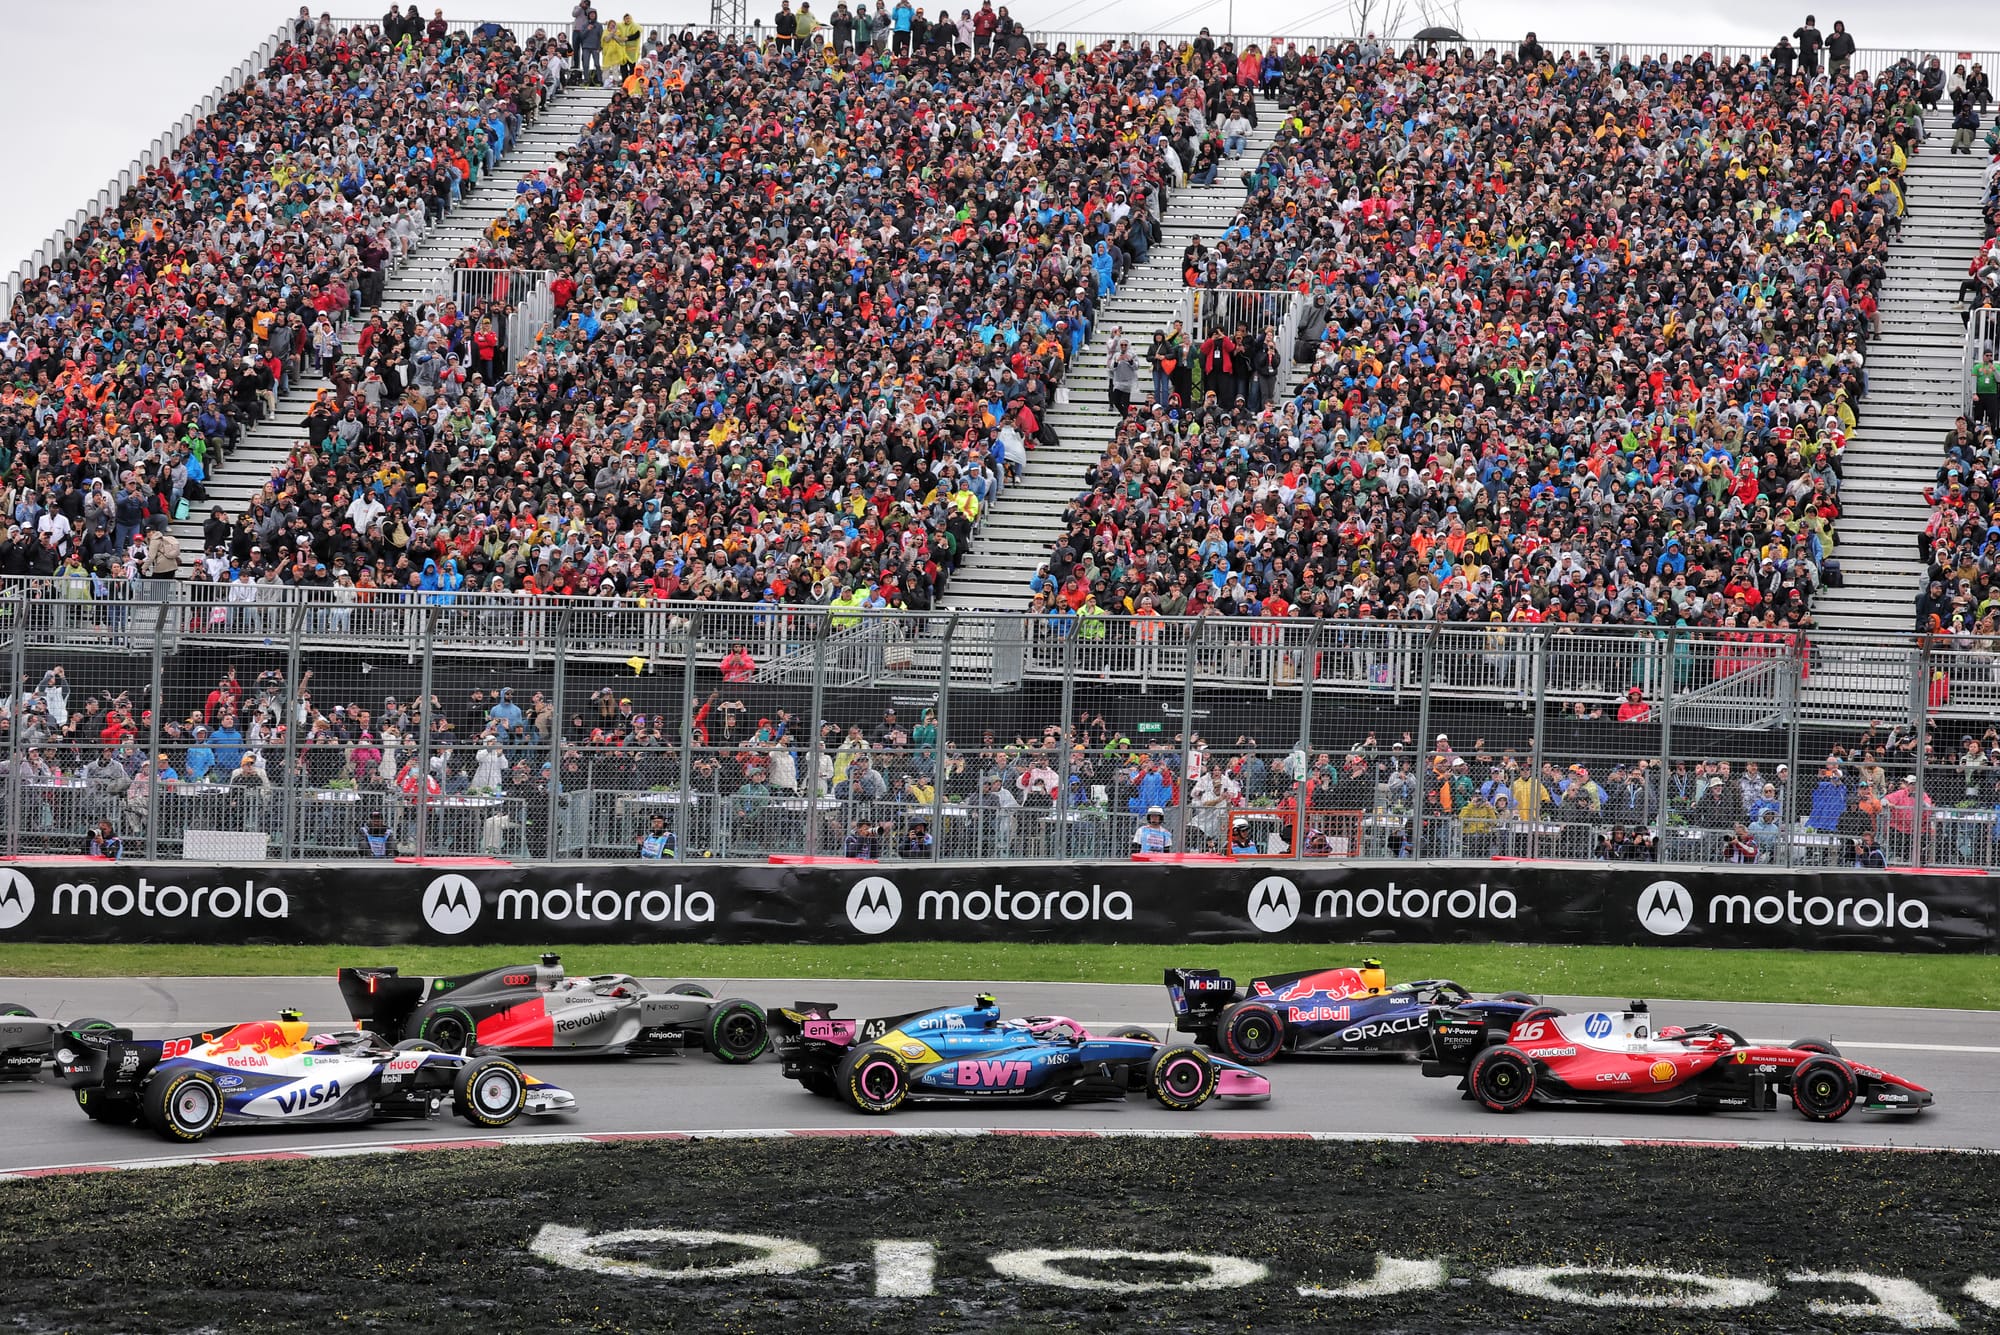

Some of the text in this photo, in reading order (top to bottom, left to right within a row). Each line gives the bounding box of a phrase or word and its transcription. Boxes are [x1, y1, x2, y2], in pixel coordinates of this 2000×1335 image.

[52, 879, 288, 918] motorola
[498, 883, 714, 922] motorola
[919, 885, 1132, 920] motorola
[1315, 883, 1516, 919] motorola
[1709, 891, 1929, 928] motorola
[1190, 980, 1220, 990] Mobil
[556, 1011, 607, 1032] Revolut
[919, 1015, 943, 1029] eni
[1288, 1005, 1350, 1022] Red Bull
[810, 1024, 829, 1036] eni
[866, 1020, 886, 1038] 43
[1342, 1013, 1429, 1042] ORACLE
[1447, 1027, 1478, 1035] V-Power
[1513, 1022, 1545, 1041] 16
[1589, 1013, 1609, 1038] hp
[82, 1034, 98, 1043] Cash
[649, 1031, 682, 1040] ninjaOne
[785, 1035, 800, 1043] MS
[162, 1039, 192, 1059] 30
[1538, 1047, 1576, 1057] UniCredit
[8, 1057, 41, 1066] ninjaOne
[227, 1055, 269, 1067] Red Bull
[390, 1060, 418, 1070] HUGO
[1047, 1053, 1070, 1065] MSC
[381, 1074, 402, 1084] Mobil
[957, 1060, 1032, 1086] BWT
[269, 1080, 341, 1114] VISA
